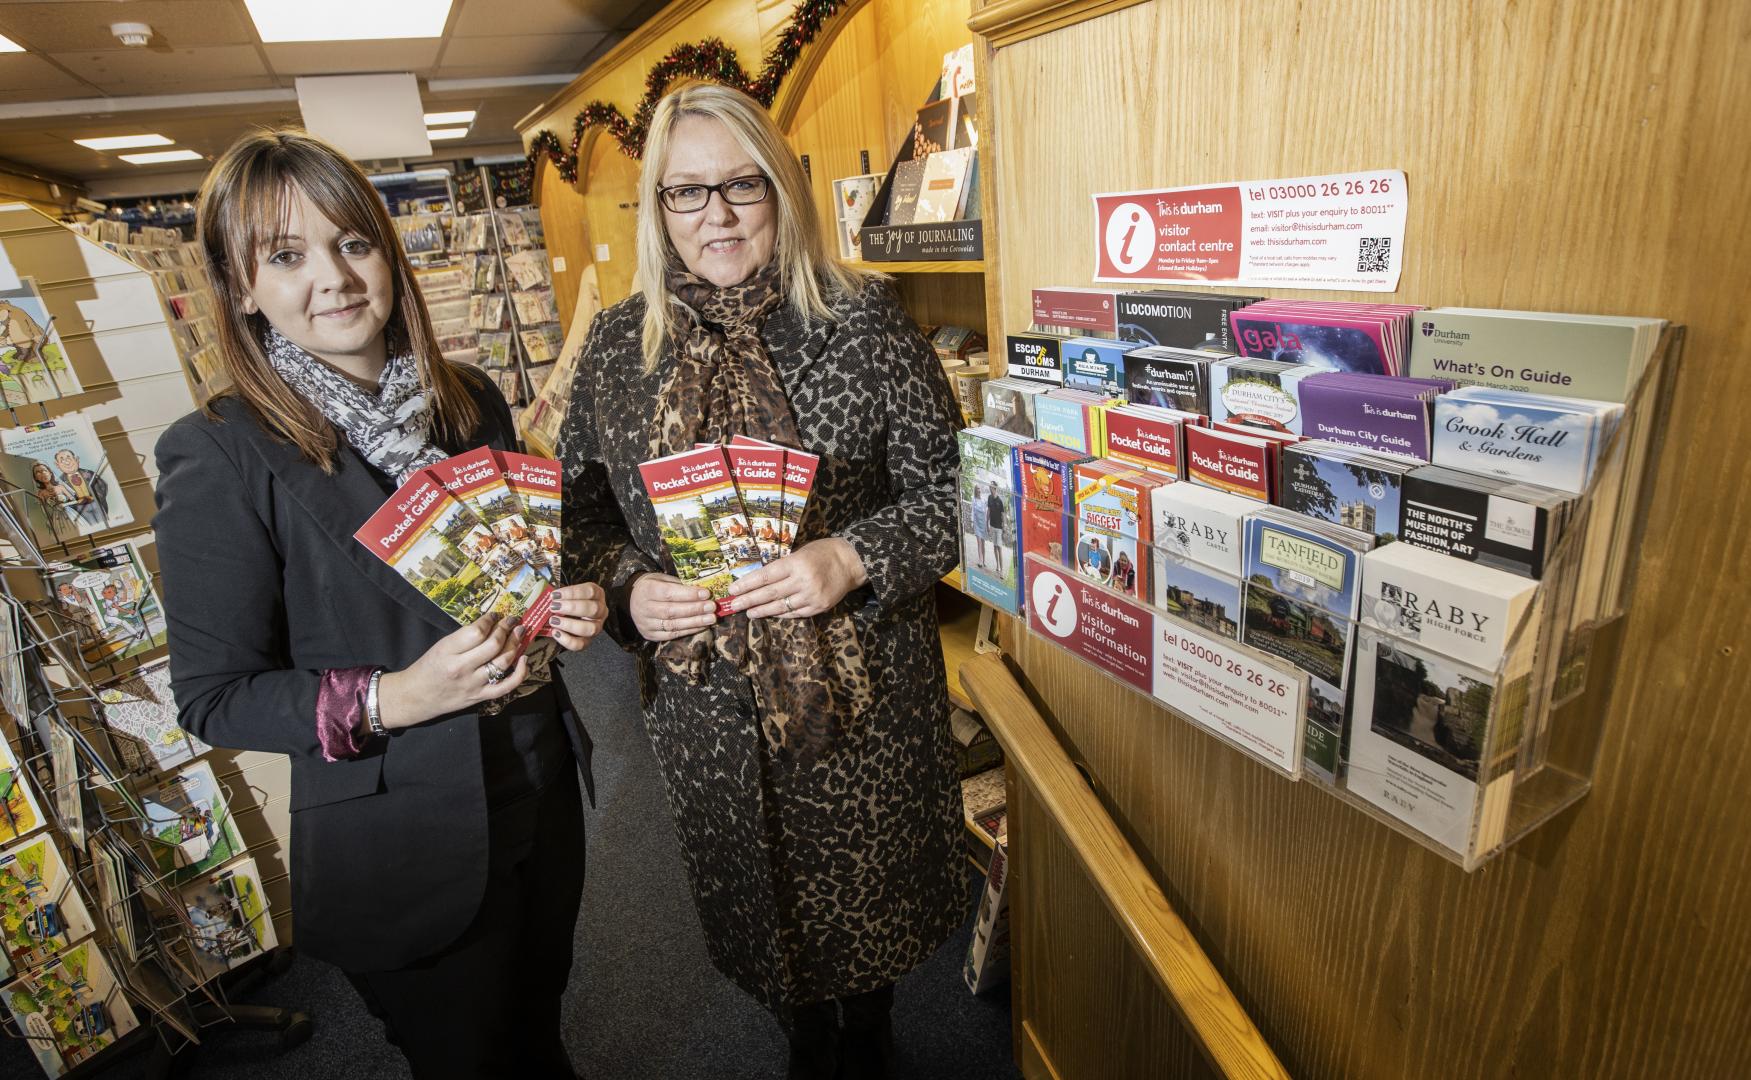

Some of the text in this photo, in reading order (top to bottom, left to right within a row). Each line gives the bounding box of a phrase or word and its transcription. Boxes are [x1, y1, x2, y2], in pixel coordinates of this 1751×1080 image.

[1249, 188, 1265, 200] tel
[1269, 184, 1316, 200] 03000
[1321, 182, 1340, 197] 26
[1345, 181, 1364, 195] 26
[1180, 201, 1223, 215] durham
[1267, 210, 1284, 219] VISIT
[1285, 209, 1300, 220] plus
[1302, 209, 1318, 220] your
[1319, 207, 1349, 219] enquiry
[1350, 206, 1359, 215] to
[1159, 224, 1191, 236] visitor
[1250, 222, 1363, 233] email: visitor@thisisdurham.com
[869, 233, 885, 245] THE
[904, 231, 915, 244] OF
[918, 228, 974, 245] JOURNALING
[1159, 238, 1234, 252] contact centre
[1250, 238, 1327, 246] web: thisisdurham.com
[940, 245, 948, 253] the
[1126, 303, 1192, 319] LOCOMOTION
[1243, 324, 1303, 353] gala
[1434, 329, 1470, 340] Durham
[1434, 338, 1464, 347] University
[1015, 343, 1047, 357] ESCAPE
[1025, 354, 1055, 367] ROOMS
[1021, 367, 1050, 378] DURHAM
[1144, 363, 1194, 382] #durham19
[1433, 358, 1572, 386] What's On Guide
[1460, 378, 1475, 386] 2019
[1486, 382, 1508, 390] March
[1509, 384, 1530, 393] 2020
[1382, 408, 1417, 420] durham
[1148, 432, 1171, 444] durham
[1318, 423, 1412, 448] Durham City Guide
[1446, 416, 1569, 448] Crook Hall
[1110, 433, 1171, 458] Pocket Guide
[1458, 441, 1543, 463] & Gardens
[466, 459, 490, 471] durham
[695, 460, 720, 471] durham
[786, 462, 810, 474] durham
[1192, 451, 1223, 473] Pocket
[1225, 464, 1259, 482] Guide
[1231, 455, 1259, 468] durham
[463, 467, 494, 484] Guide
[502, 470, 557, 487] cket Guide
[533, 466, 557, 476] durham
[743, 467, 777, 479] Guide
[784, 472, 807, 485] uide
[652, 475, 691, 492] Pocket
[690, 468, 723, 483] Guide
[1294, 481, 1318, 491] DURHAM
[410, 482, 431, 503] durham
[1295, 487, 1325, 500] CATHEDRAL
[380, 513, 416, 549] Pocket
[411, 489, 440, 516] Guide
[1086, 512, 1122, 530] BIGGEST
[1406, 507, 1473, 532] THE NORTH'S
[1177, 516, 1228, 545] RABY
[1405, 519, 1466, 541] MUSEUM OF
[1206, 541, 1229, 553] CASTLE
[1404, 529, 1475, 555] FASHION, ART
[1268, 535, 1338, 570] TANFIELD
[1080, 586, 1140, 628] This is durham
[1404, 590, 1490, 632] RABY
[1081, 612, 1117, 636] visitor
[1426, 617, 1487, 643] HIGH FORCE
[1081, 622, 1147, 665] information
[1163, 629, 1178, 647] tel
[1180, 638, 1222, 667] 03000
[1226, 659, 1242, 677] 26
[1246, 669, 1264, 687] 26
[1162, 671, 1229, 708] web: thisisdurham.com
[1177, 659, 1193, 673] VISIT
[1194, 669, 1207, 680] plus
[1208, 675, 1223, 688] your
[1224, 684, 1249, 701] enquiry
[1250, 696, 1257, 705] to
[1180, 671, 1259, 715] visitor@thisisdurham.com
[1307, 724, 1325, 742] IDE
